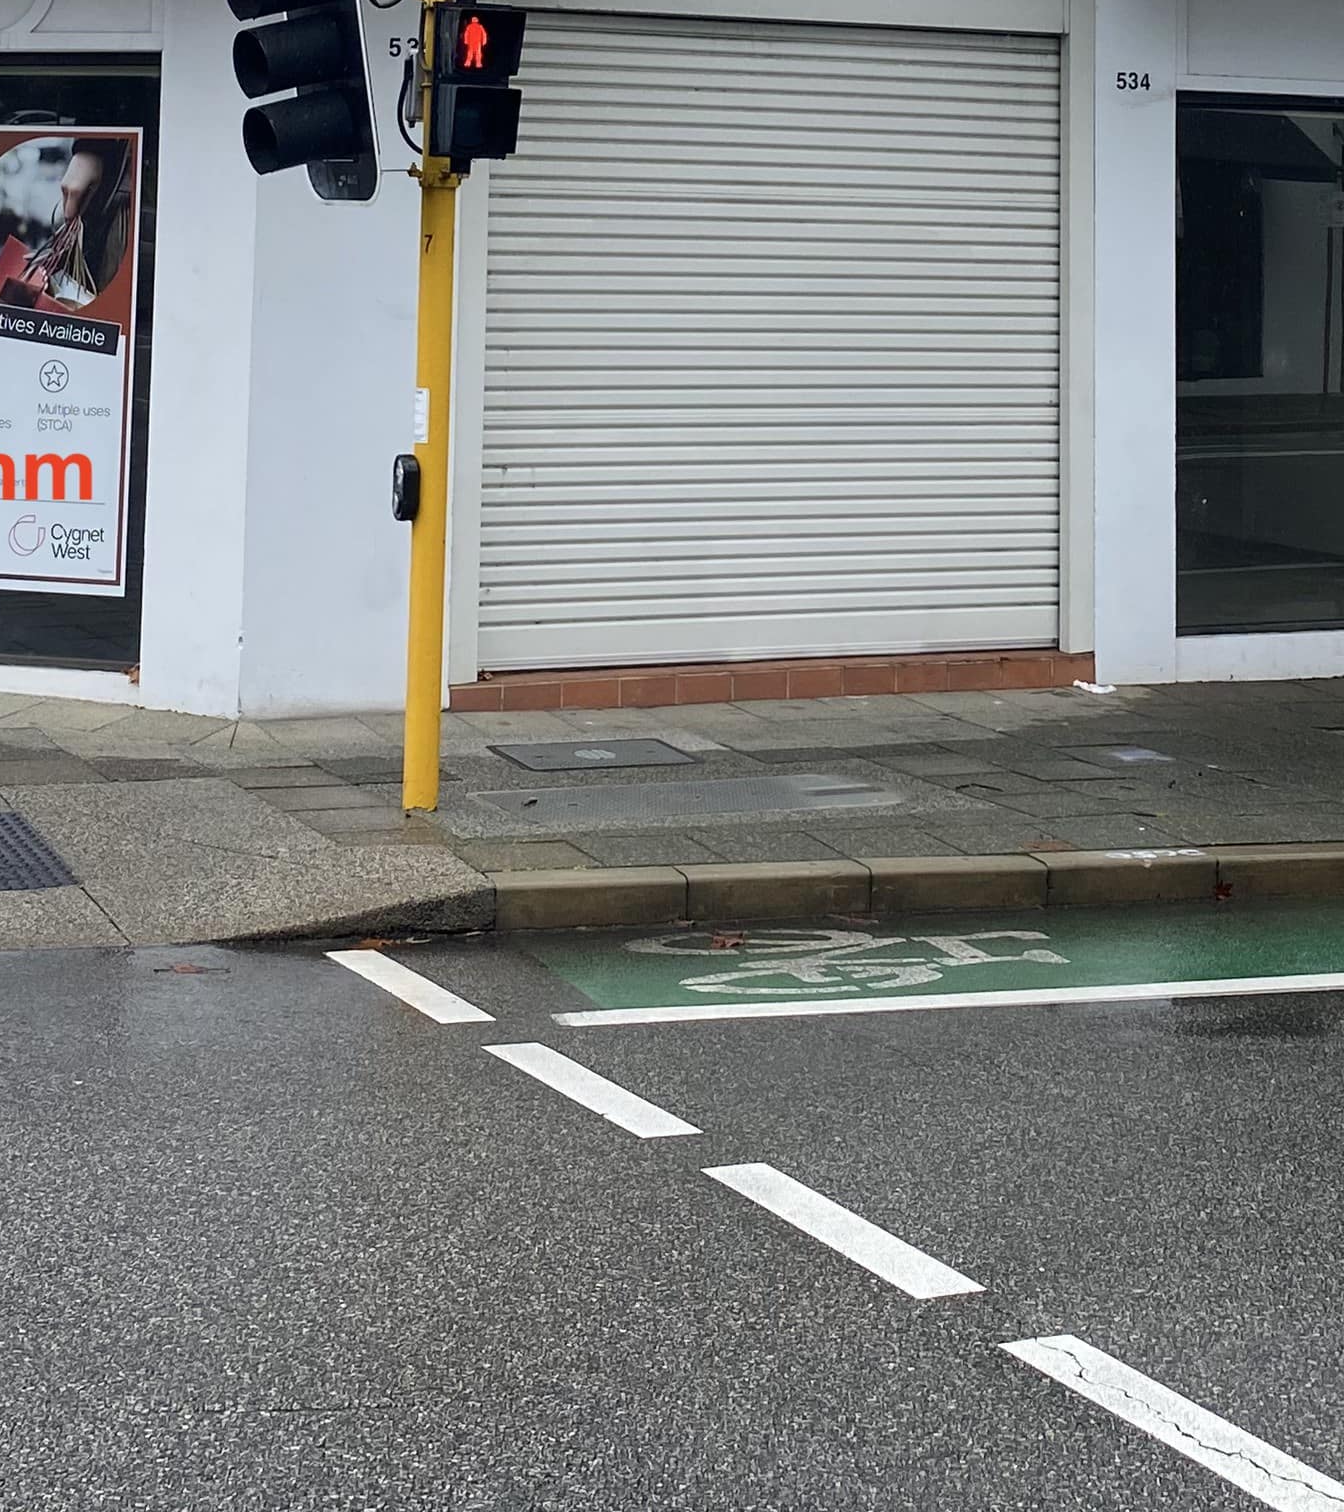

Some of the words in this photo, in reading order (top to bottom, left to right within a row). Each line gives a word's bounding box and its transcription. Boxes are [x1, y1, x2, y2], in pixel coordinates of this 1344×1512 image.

[1115, 72, 1151, 91] 534
[424, 234, 433, 254] 7
[38, 319, 106, 347] Available
[37, 403, 81, 418] Multiple
[83, 407, 111, 417] uses
[37, 418, 73, 432] (STCA)
[50, 523, 105, 546] Cygnet
[50, 542, 91, 560] West
